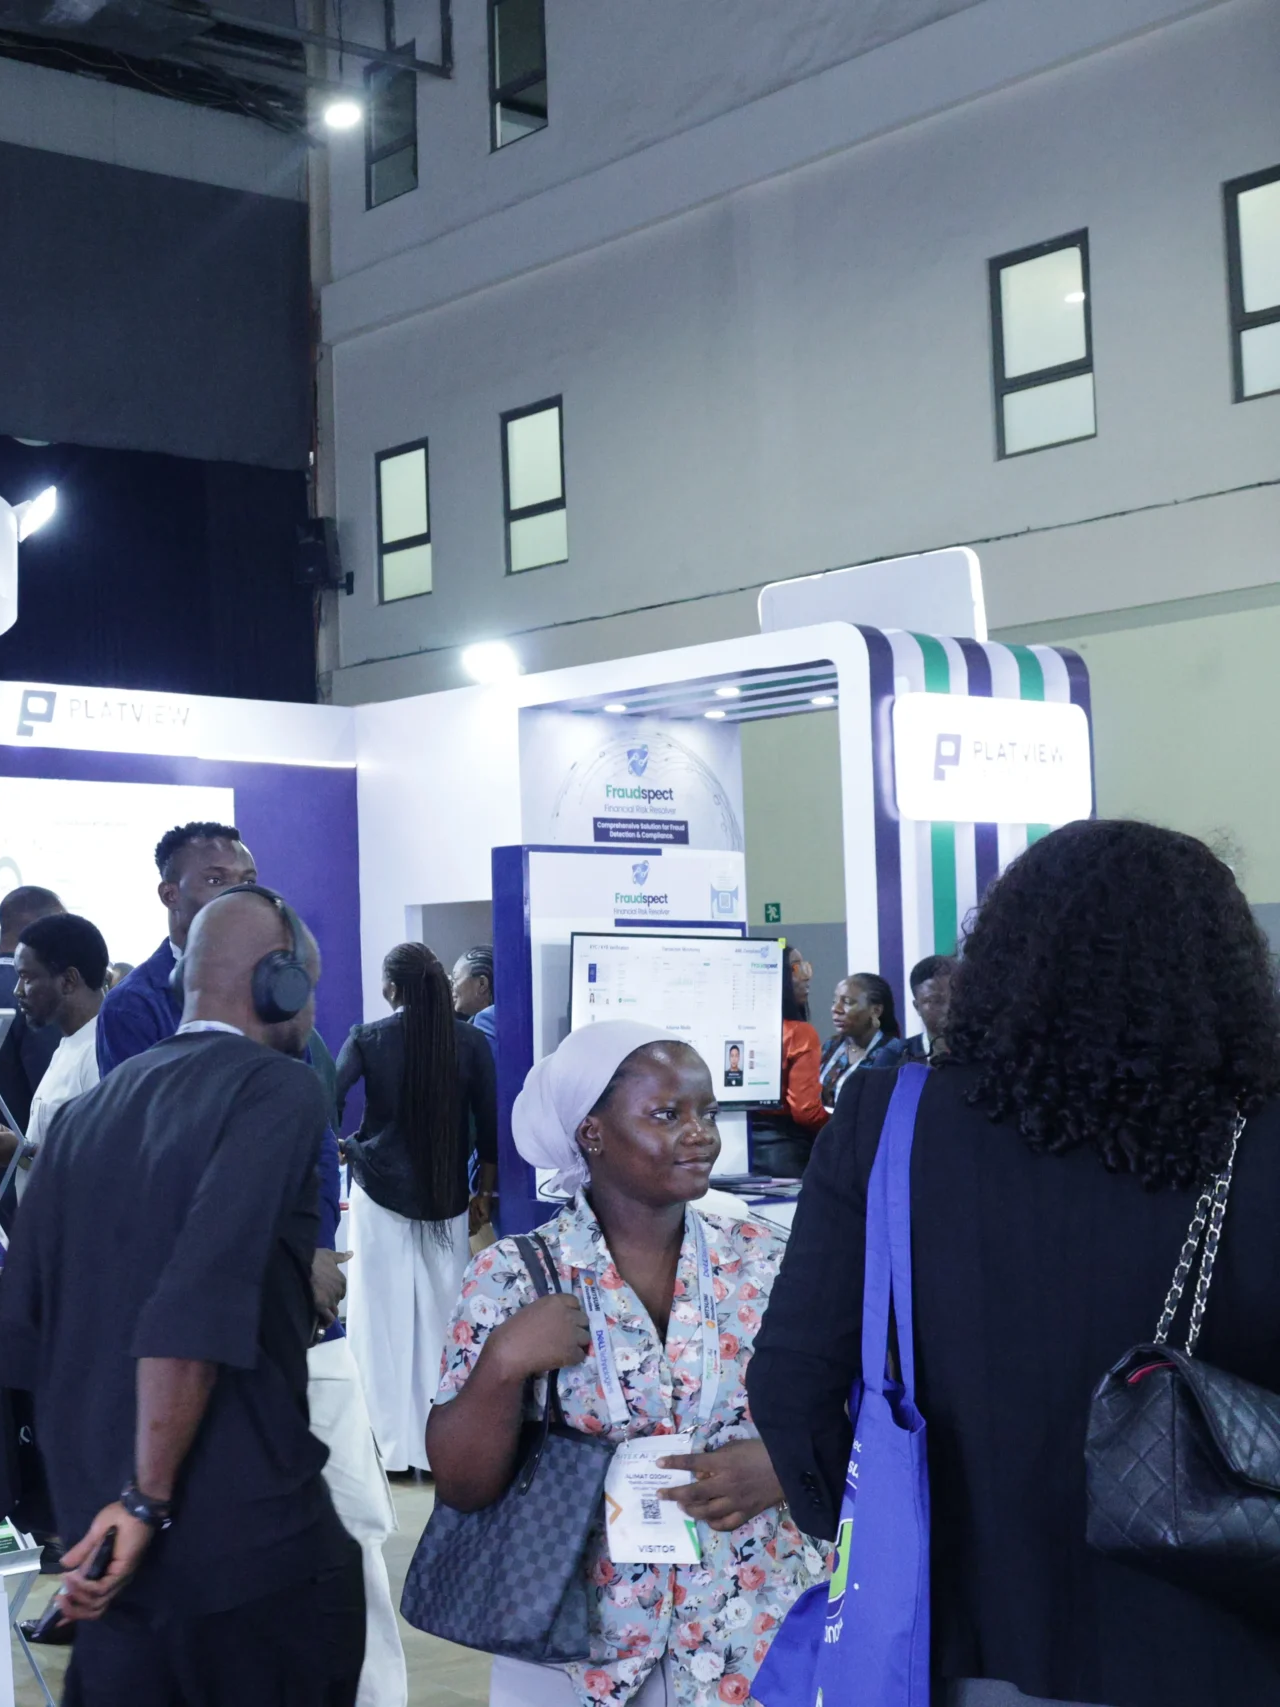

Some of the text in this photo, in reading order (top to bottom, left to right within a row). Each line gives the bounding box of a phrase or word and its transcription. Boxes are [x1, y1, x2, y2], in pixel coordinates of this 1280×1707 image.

[70, 698, 190, 727] PLATVIEW
[972, 740, 1064, 764] PLATVIEW
[606, 784, 673, 804] Fraudspect
[604, 804, 676, 815] Financial Risk Resolver
[596, 821, 639, 830] Comprehensive
[641, 832, 674, 840] Compliance.
[614, 892, 668, 907] Fraudspect
[649, 908, 670, 916] Resolver
[590, 1286, 600, 1312] MITSUMI
[638, 1545, 676, 1553] VISITOR
